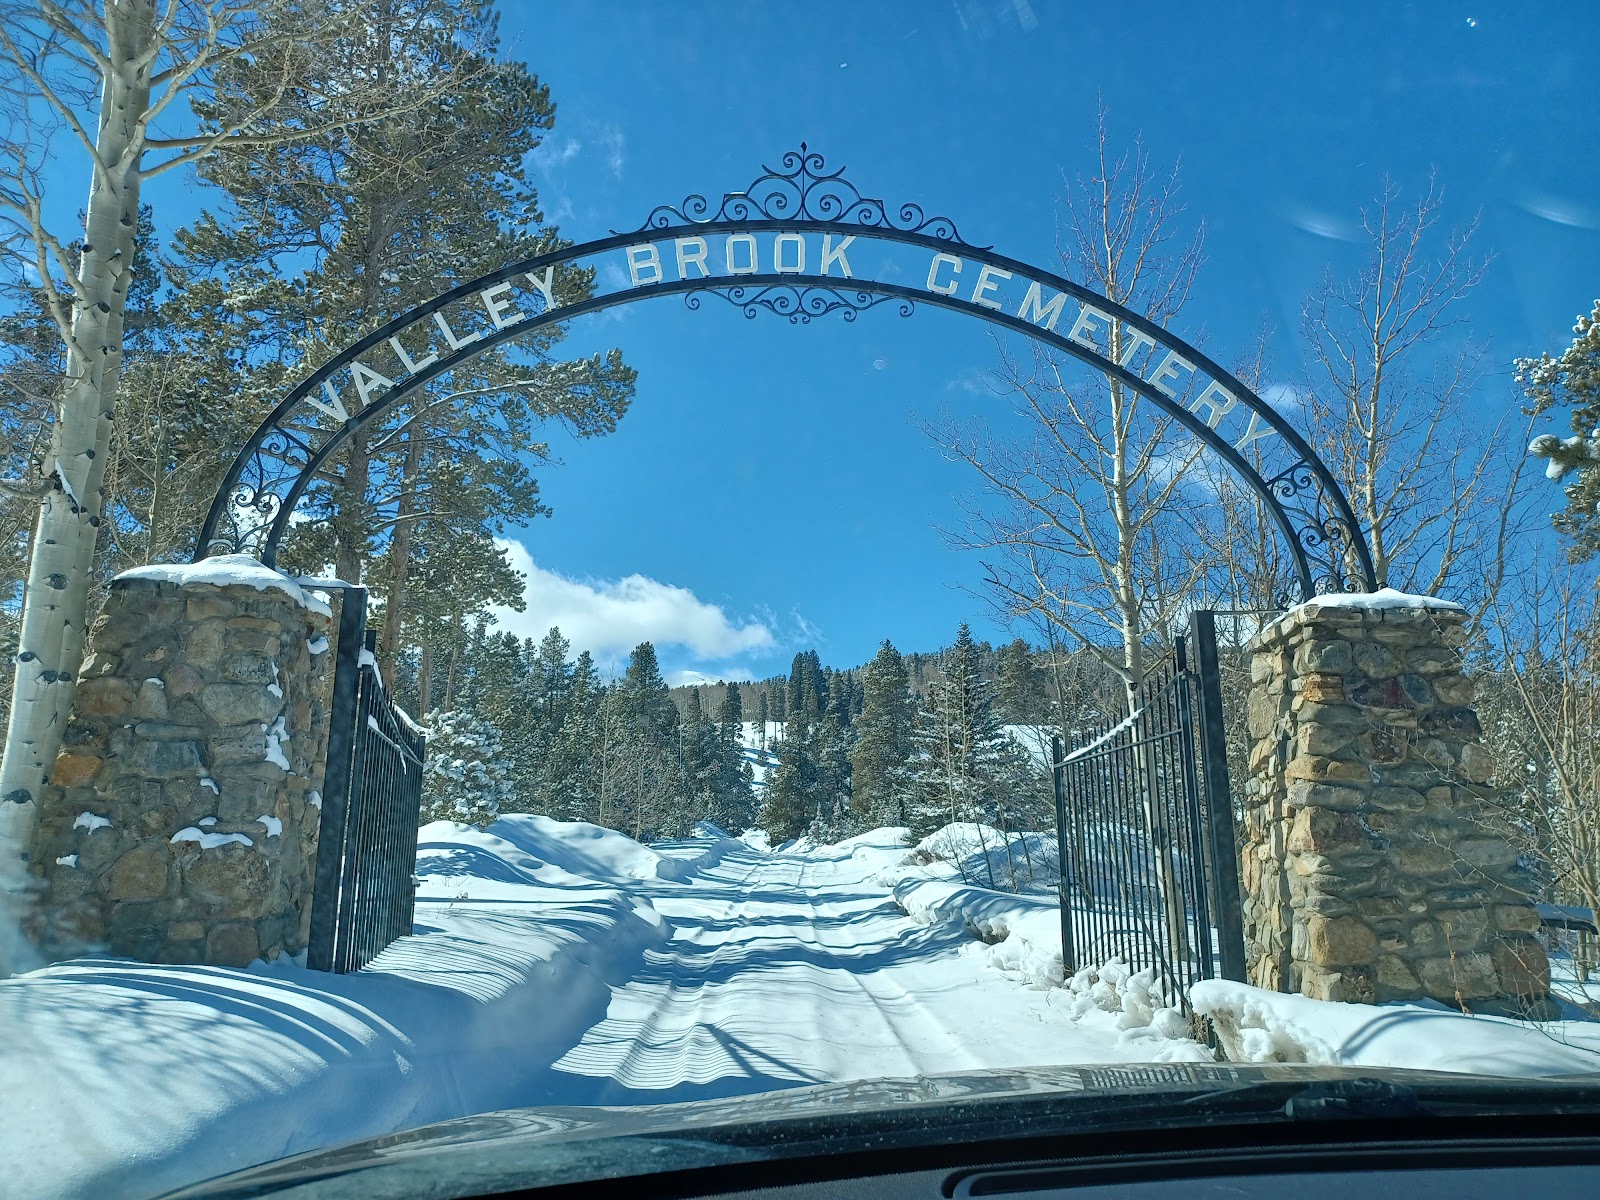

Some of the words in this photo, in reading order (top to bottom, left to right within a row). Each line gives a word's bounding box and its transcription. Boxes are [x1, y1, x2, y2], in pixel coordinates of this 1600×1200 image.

[304, 266, 556, 422] VALLEY
[626, 233, 856, 287] BROOK
[926, 252, 1278, 451] CEMETERY
